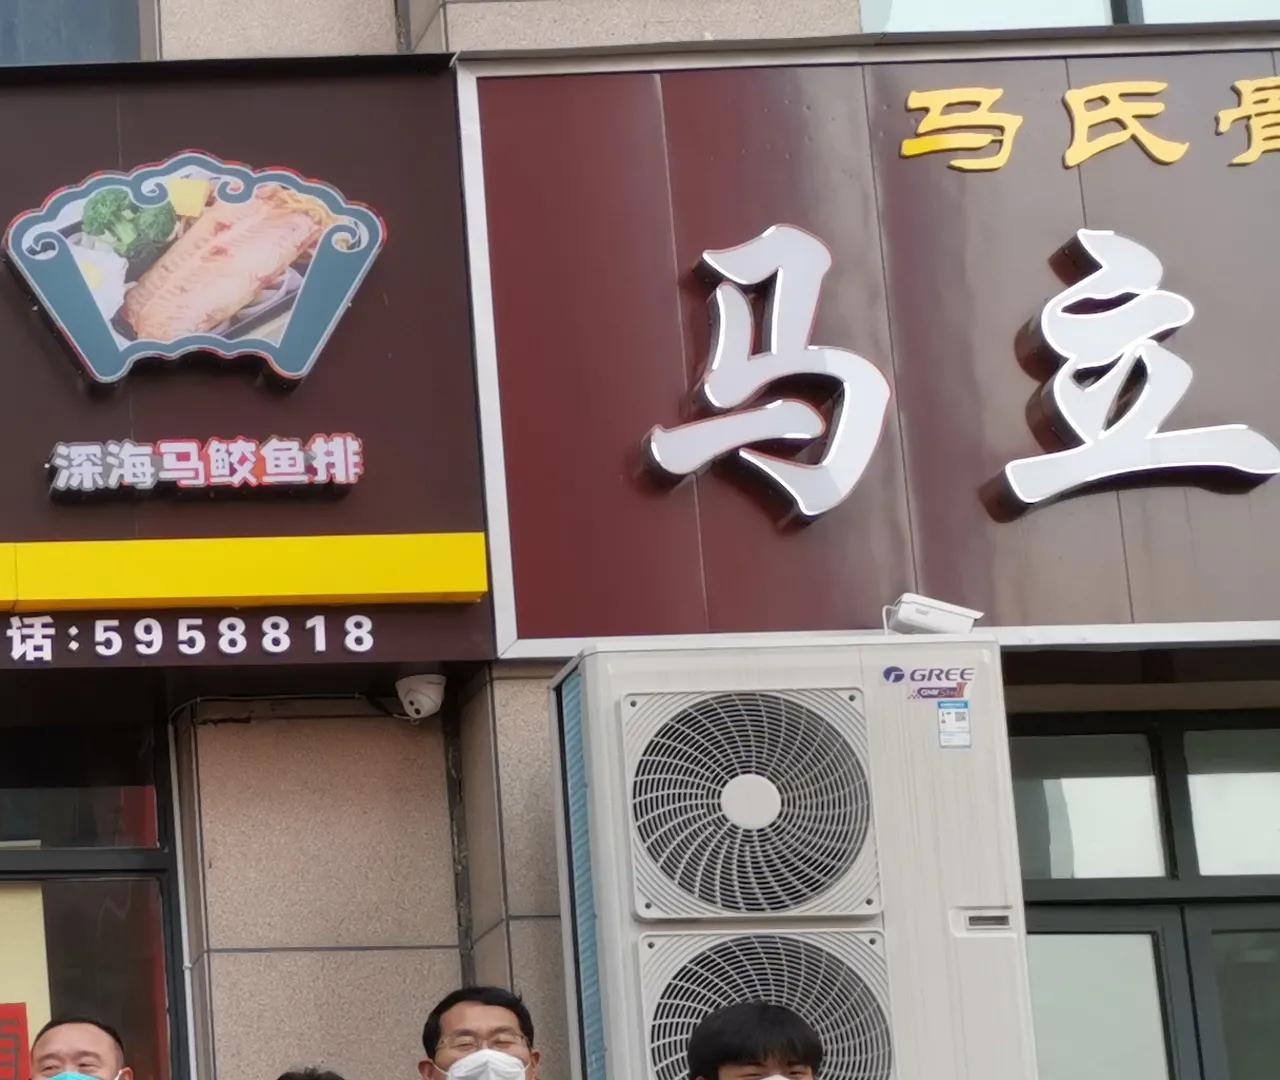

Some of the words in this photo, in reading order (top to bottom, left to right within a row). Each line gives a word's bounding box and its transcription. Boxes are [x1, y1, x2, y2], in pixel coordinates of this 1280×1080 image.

[52, 433, 364, 490] 深海马鲛鱼排
[910, 667, 975, 681] GREE
